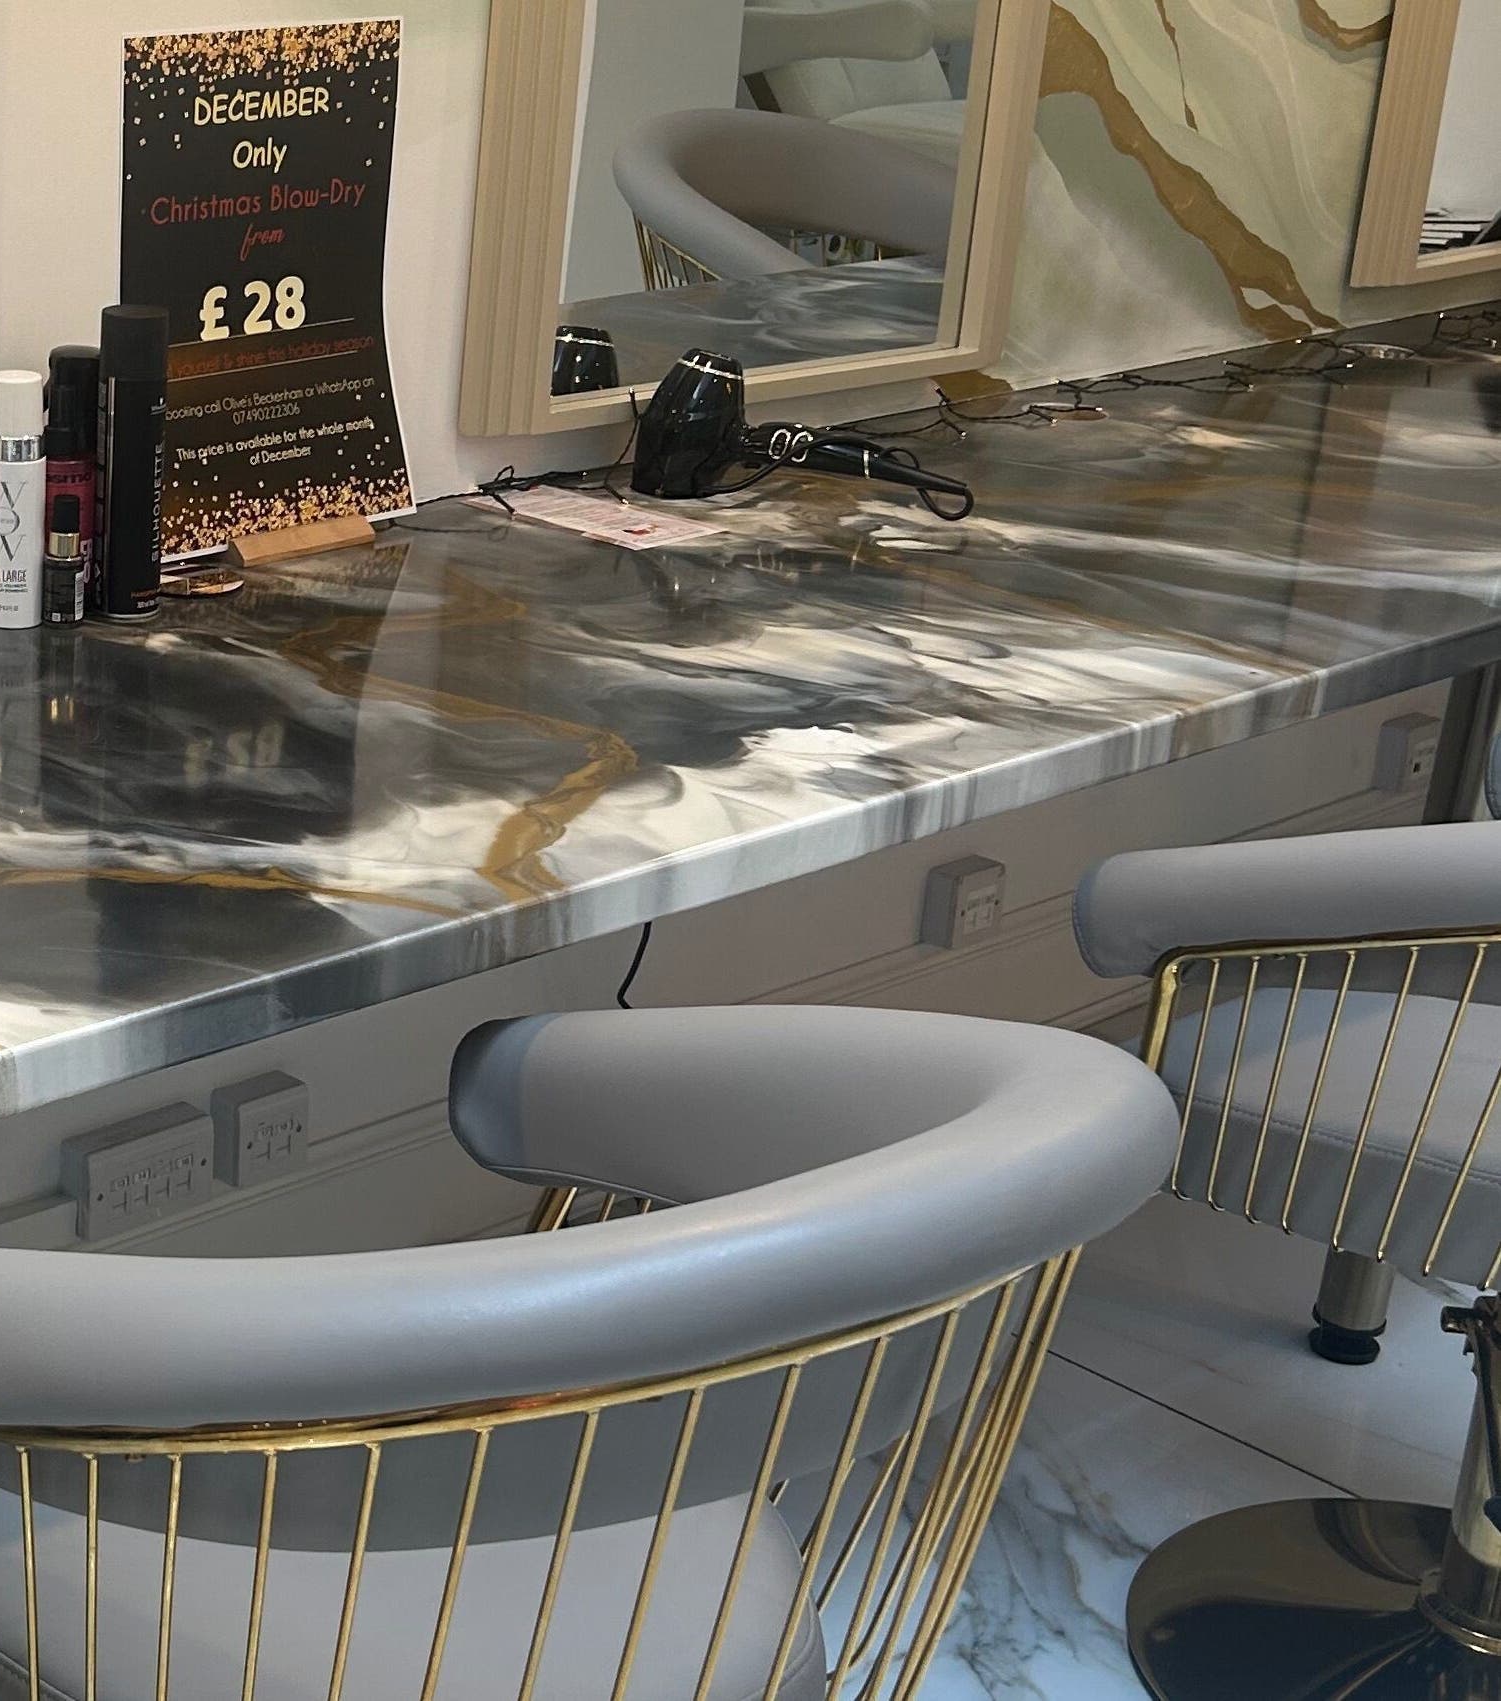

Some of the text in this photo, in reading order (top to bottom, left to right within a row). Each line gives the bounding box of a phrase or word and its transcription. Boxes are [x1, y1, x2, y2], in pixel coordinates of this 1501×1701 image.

[193, 86, 330, 126] DECEMBER
[232, 137, 288, 174] Only
[150, 178, 366, 225] Christmas Blow-Dry
[240, 222, 286, 262] from
[204, 400, 221, 414] call
[221, 393, 252, 411] Olive's
[305, 388, 315, 397] or
[315, 379, 362, 397] WhatsApp
[363, 376, 375, 387] on
[176, 447, 196, 462] This
[198, 444, 225, 461] price
[226, 441, 234, 453] is
[236, 432, 282, 452] available
[283, 429, 298, 443] for
[299, 425, 316, 439] the
[316, 421, 344, 437] whole
[249, 445, 311, 466] of December
[151, 443, 164, 562] SILHOUETTE
[2, 569, 27, 583] LARGE
